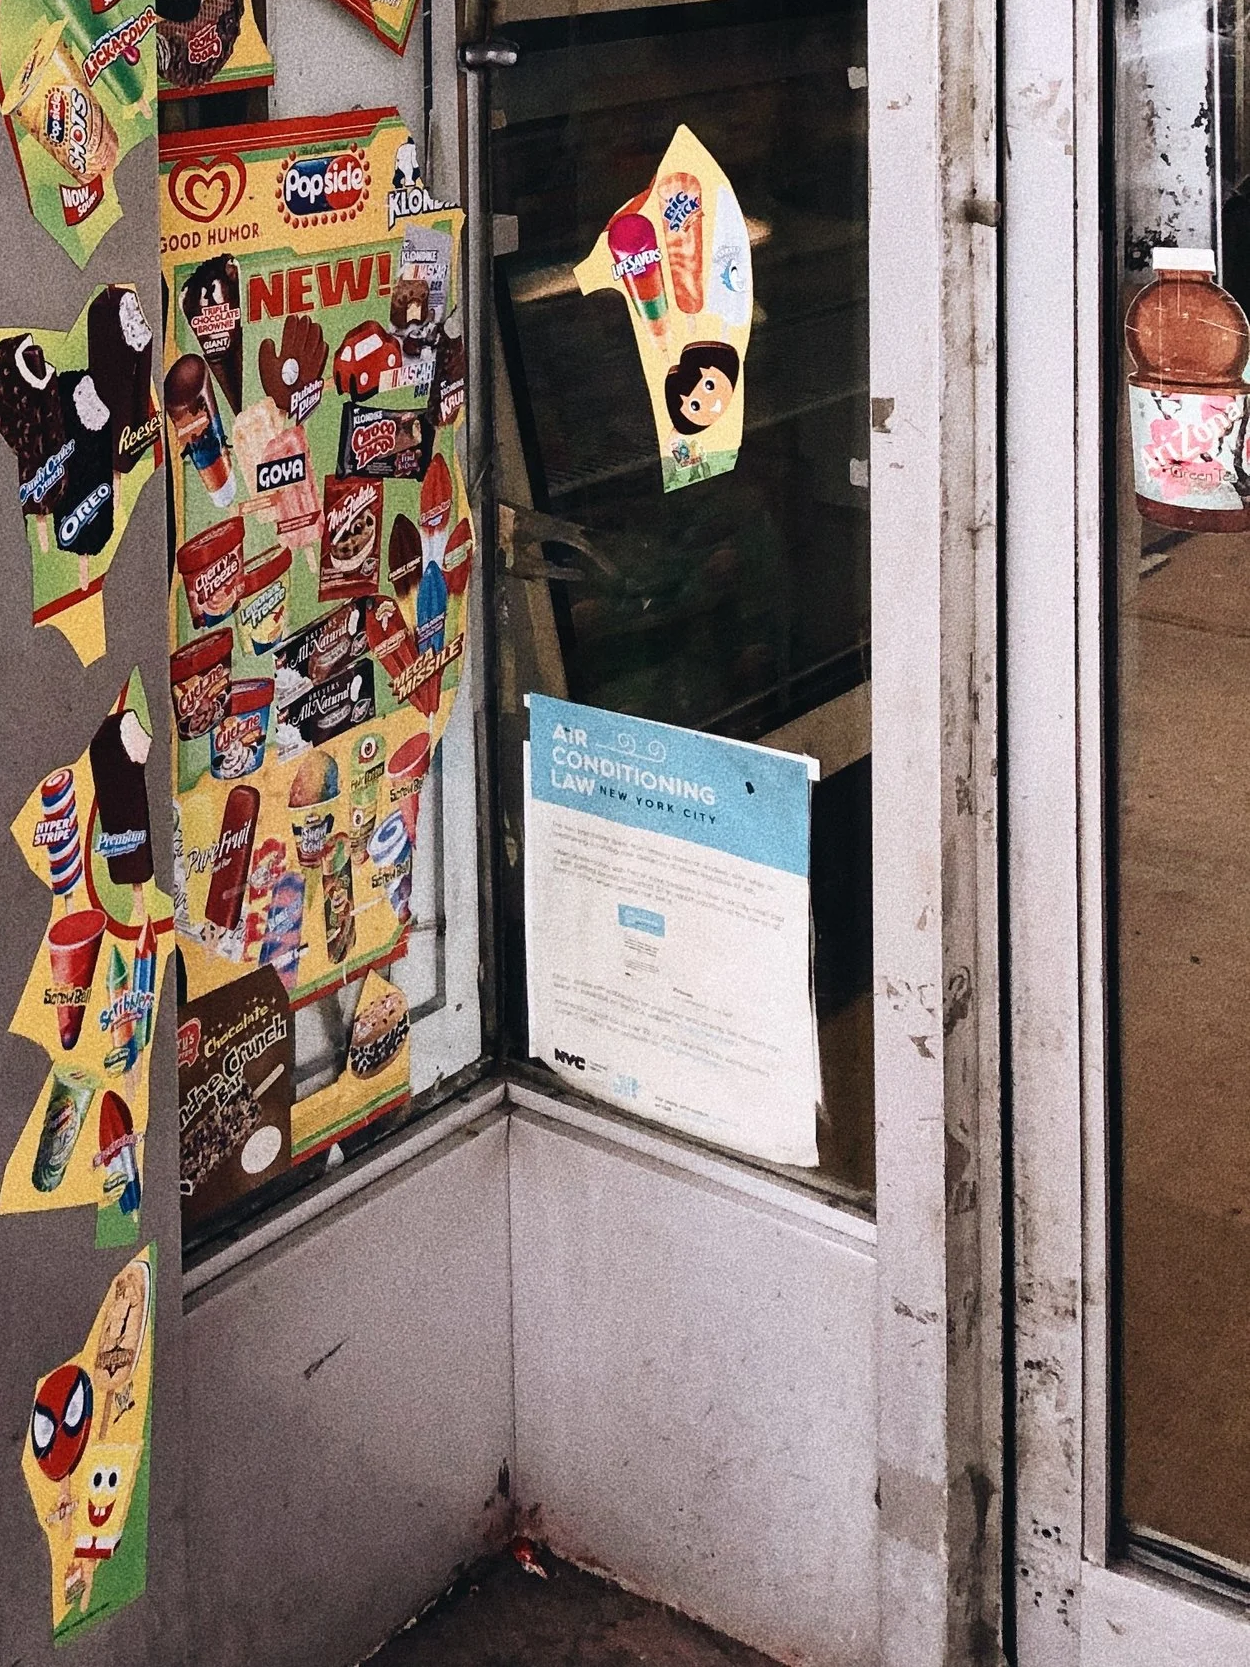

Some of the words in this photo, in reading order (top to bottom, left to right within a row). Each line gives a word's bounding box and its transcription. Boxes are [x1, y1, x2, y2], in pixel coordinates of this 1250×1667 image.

[68, 88, 90, 175] SHOTS
[60, 185, 90, 208] NOW
[285, 162, 365, 203] Popsicle
[159, 230, 201, 253] GOOD
[207, 222, 260, 246] HUMOR
[611, 247, 663, 282] LIFESAVERS
[248, 251, 393, 324] NEW!
[192, 309, 240, 327] CHOCOLATE
[198, 319, 235, 334] BROWNIE
[202, 304, 230, 315] TRIPLE
[203, 336, 230, 351] GIANT
[118, 413, 164, 455] Reese's
[258, 457, 304, 488] GOYA
[1169, 464, 1214, 483] Green
[1216, 468, 1239, 483] Tea
[60, 484, 111, 542] OREO
[195, 554, 231, 592] Cherry
[203, 561, 239, 600] Freeze
[250, 587, 286, 629] Freeze
[393, 647, 435, 686] MEGA
[398, 635, 463, 703] MISSILE
[178, 664, 224, 714] Cyclone
[214, 713, 261, 752] Cyclone
[551, 747, 717, 807] CONDITIONING
[551, 767, 596, 797] LAW
[599, 785, 628, 801] NEW
[635, 796, 675, 814] YORK
[683, 808, 718, 826] CITY
[33, 829, 71, 846] STRIPE
[36, 818, 71, 835] HYPER
[204, 1003, 270, 1058] Chocolate
[222, 1013, 287, 1078] Crunch
[554, 1048, 586, 1072] NYC
[214, 1069, 244, 1110] Bar
